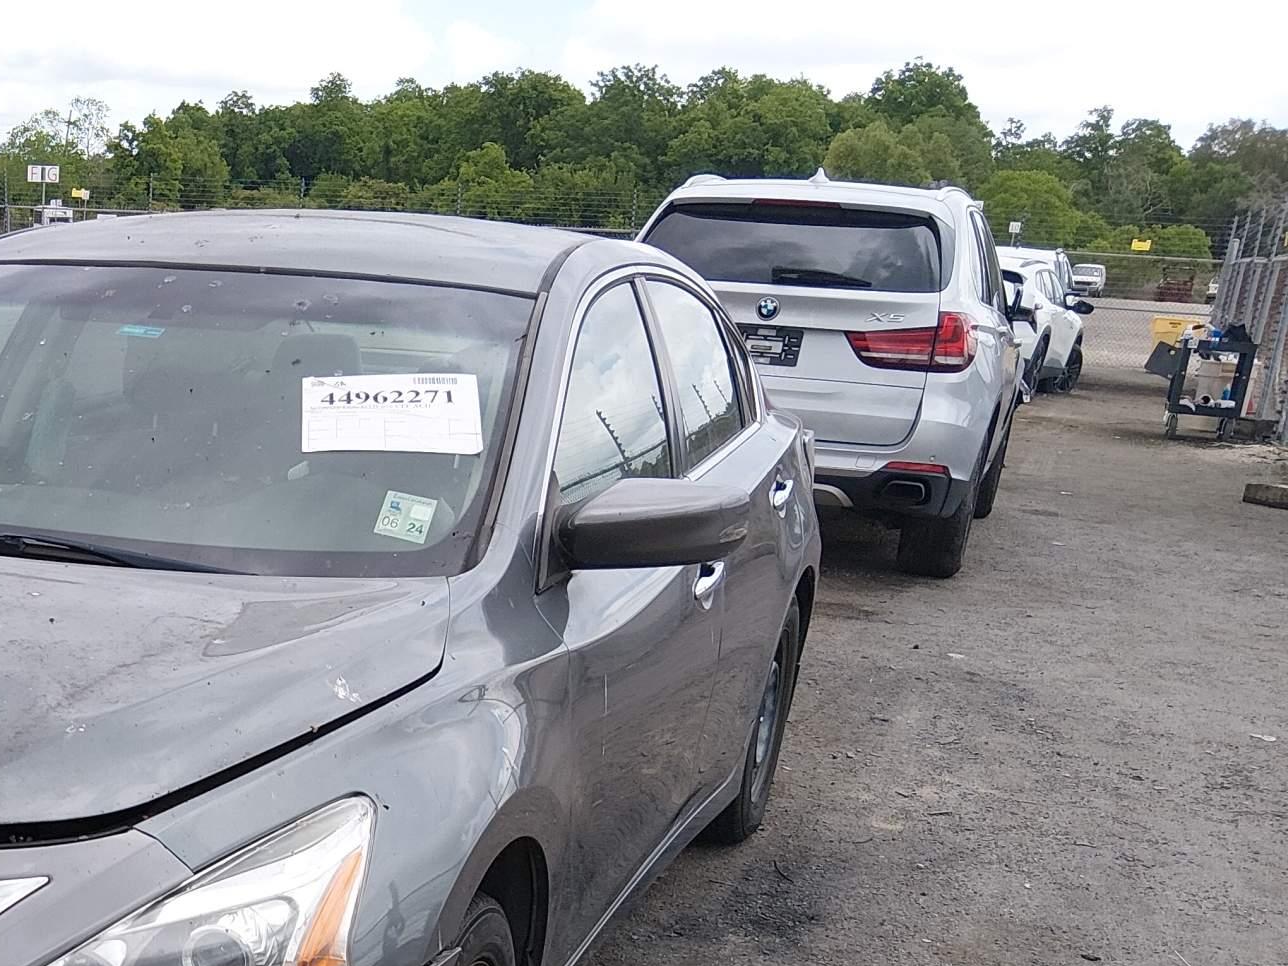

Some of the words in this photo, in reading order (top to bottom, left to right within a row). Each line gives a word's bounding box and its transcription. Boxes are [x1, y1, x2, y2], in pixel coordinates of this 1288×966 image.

[31, 166, 38, 181] F
[47, 167, 58, 182] G
[866, 311, 906, 323] X5
[320, 389, 456, 407] 44962271
[381, 515, 400, 529] 06
[406, 522, 424, 536] 24
